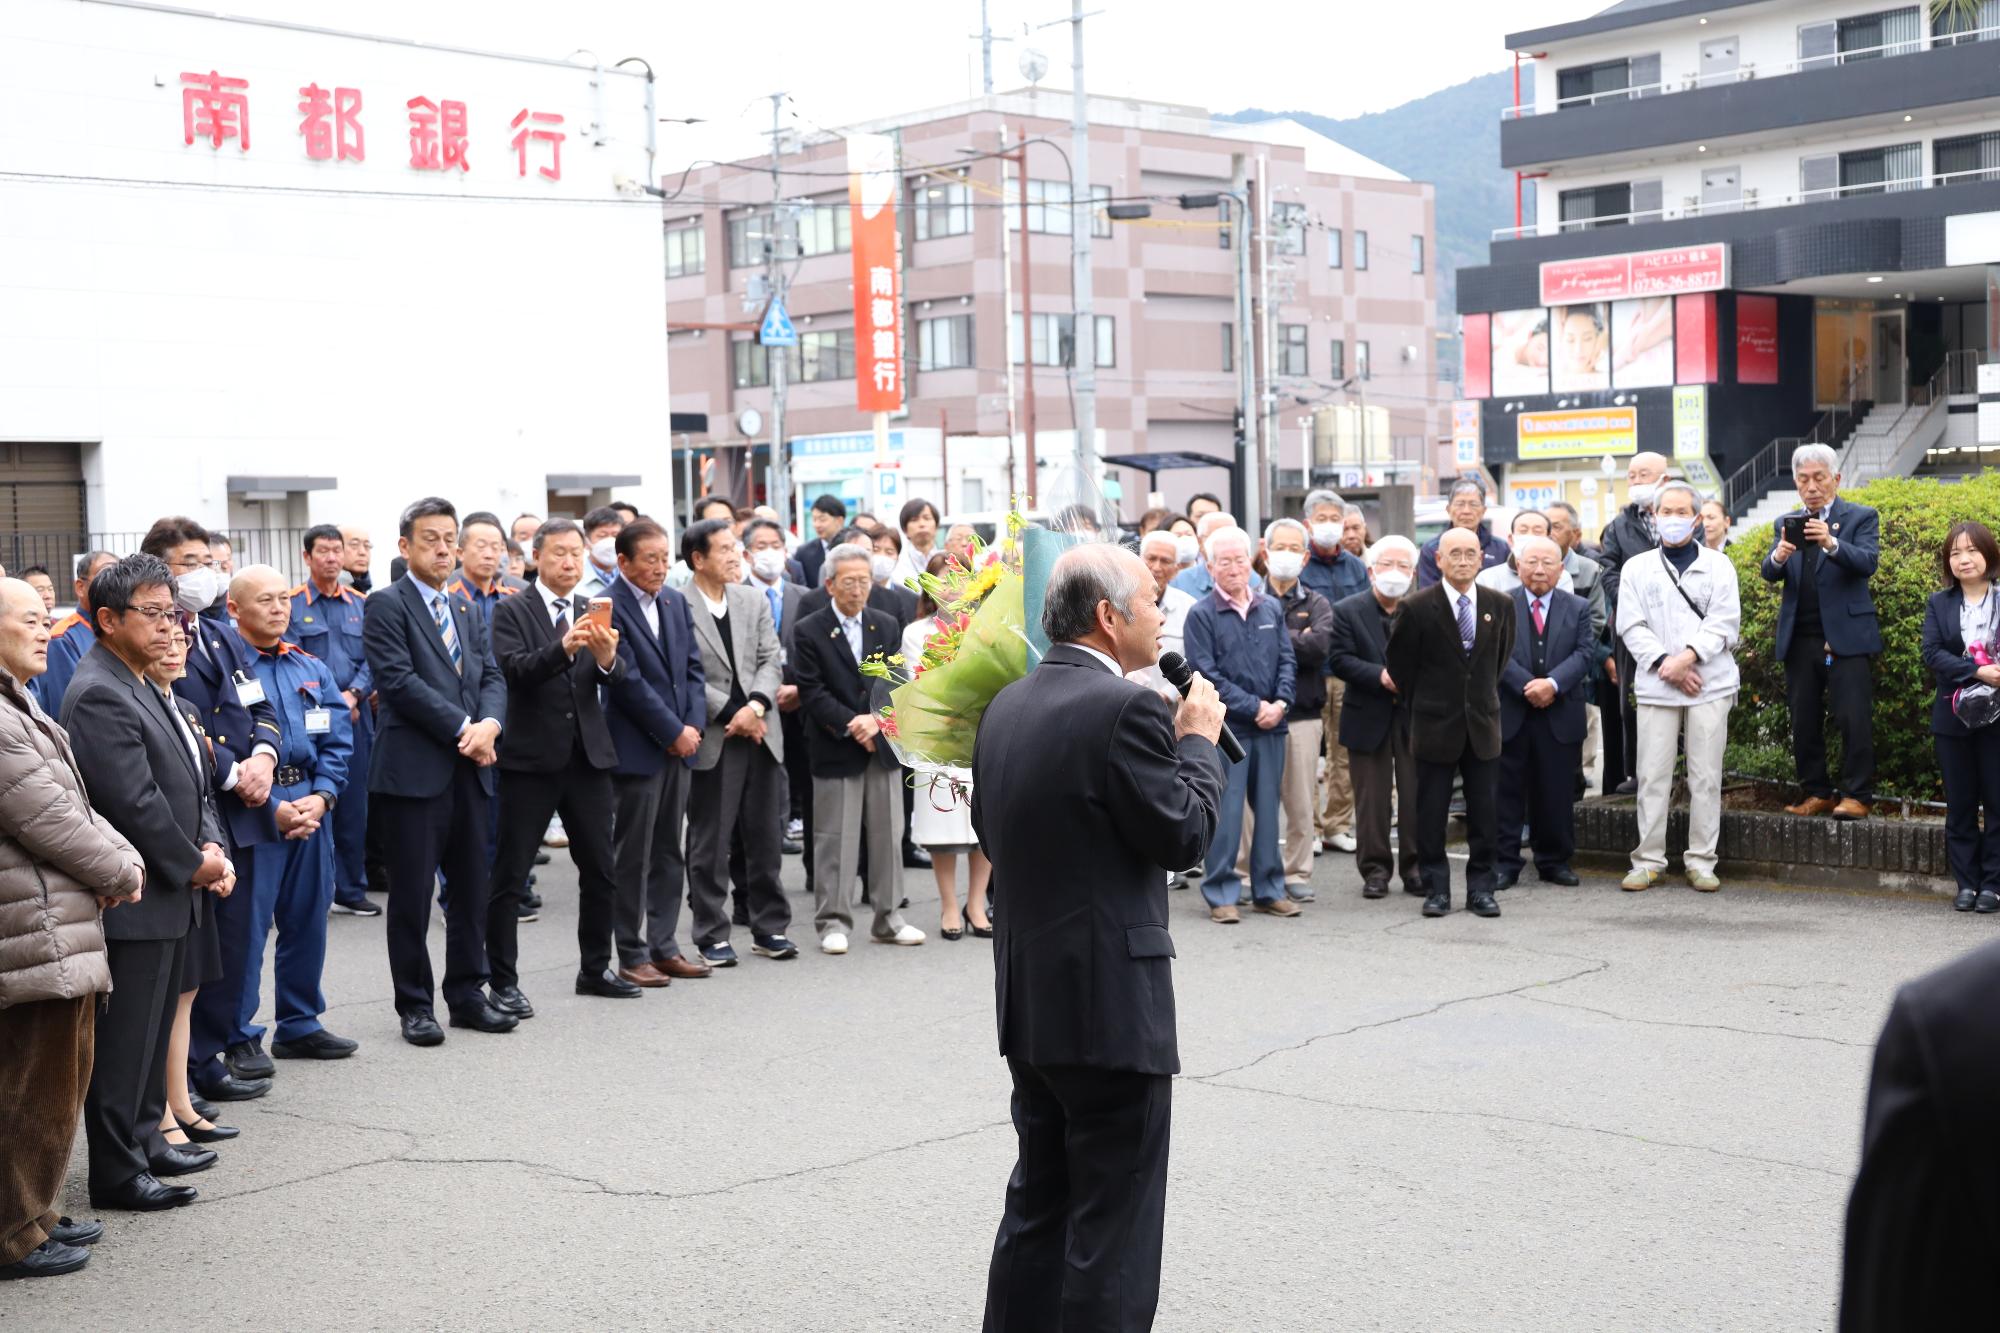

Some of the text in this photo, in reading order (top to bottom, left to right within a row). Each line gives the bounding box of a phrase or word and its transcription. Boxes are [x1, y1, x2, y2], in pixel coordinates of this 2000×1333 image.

[180, 70, 566, 181] 南都銀行
[870, 266, 897, 393] 南都銀行
